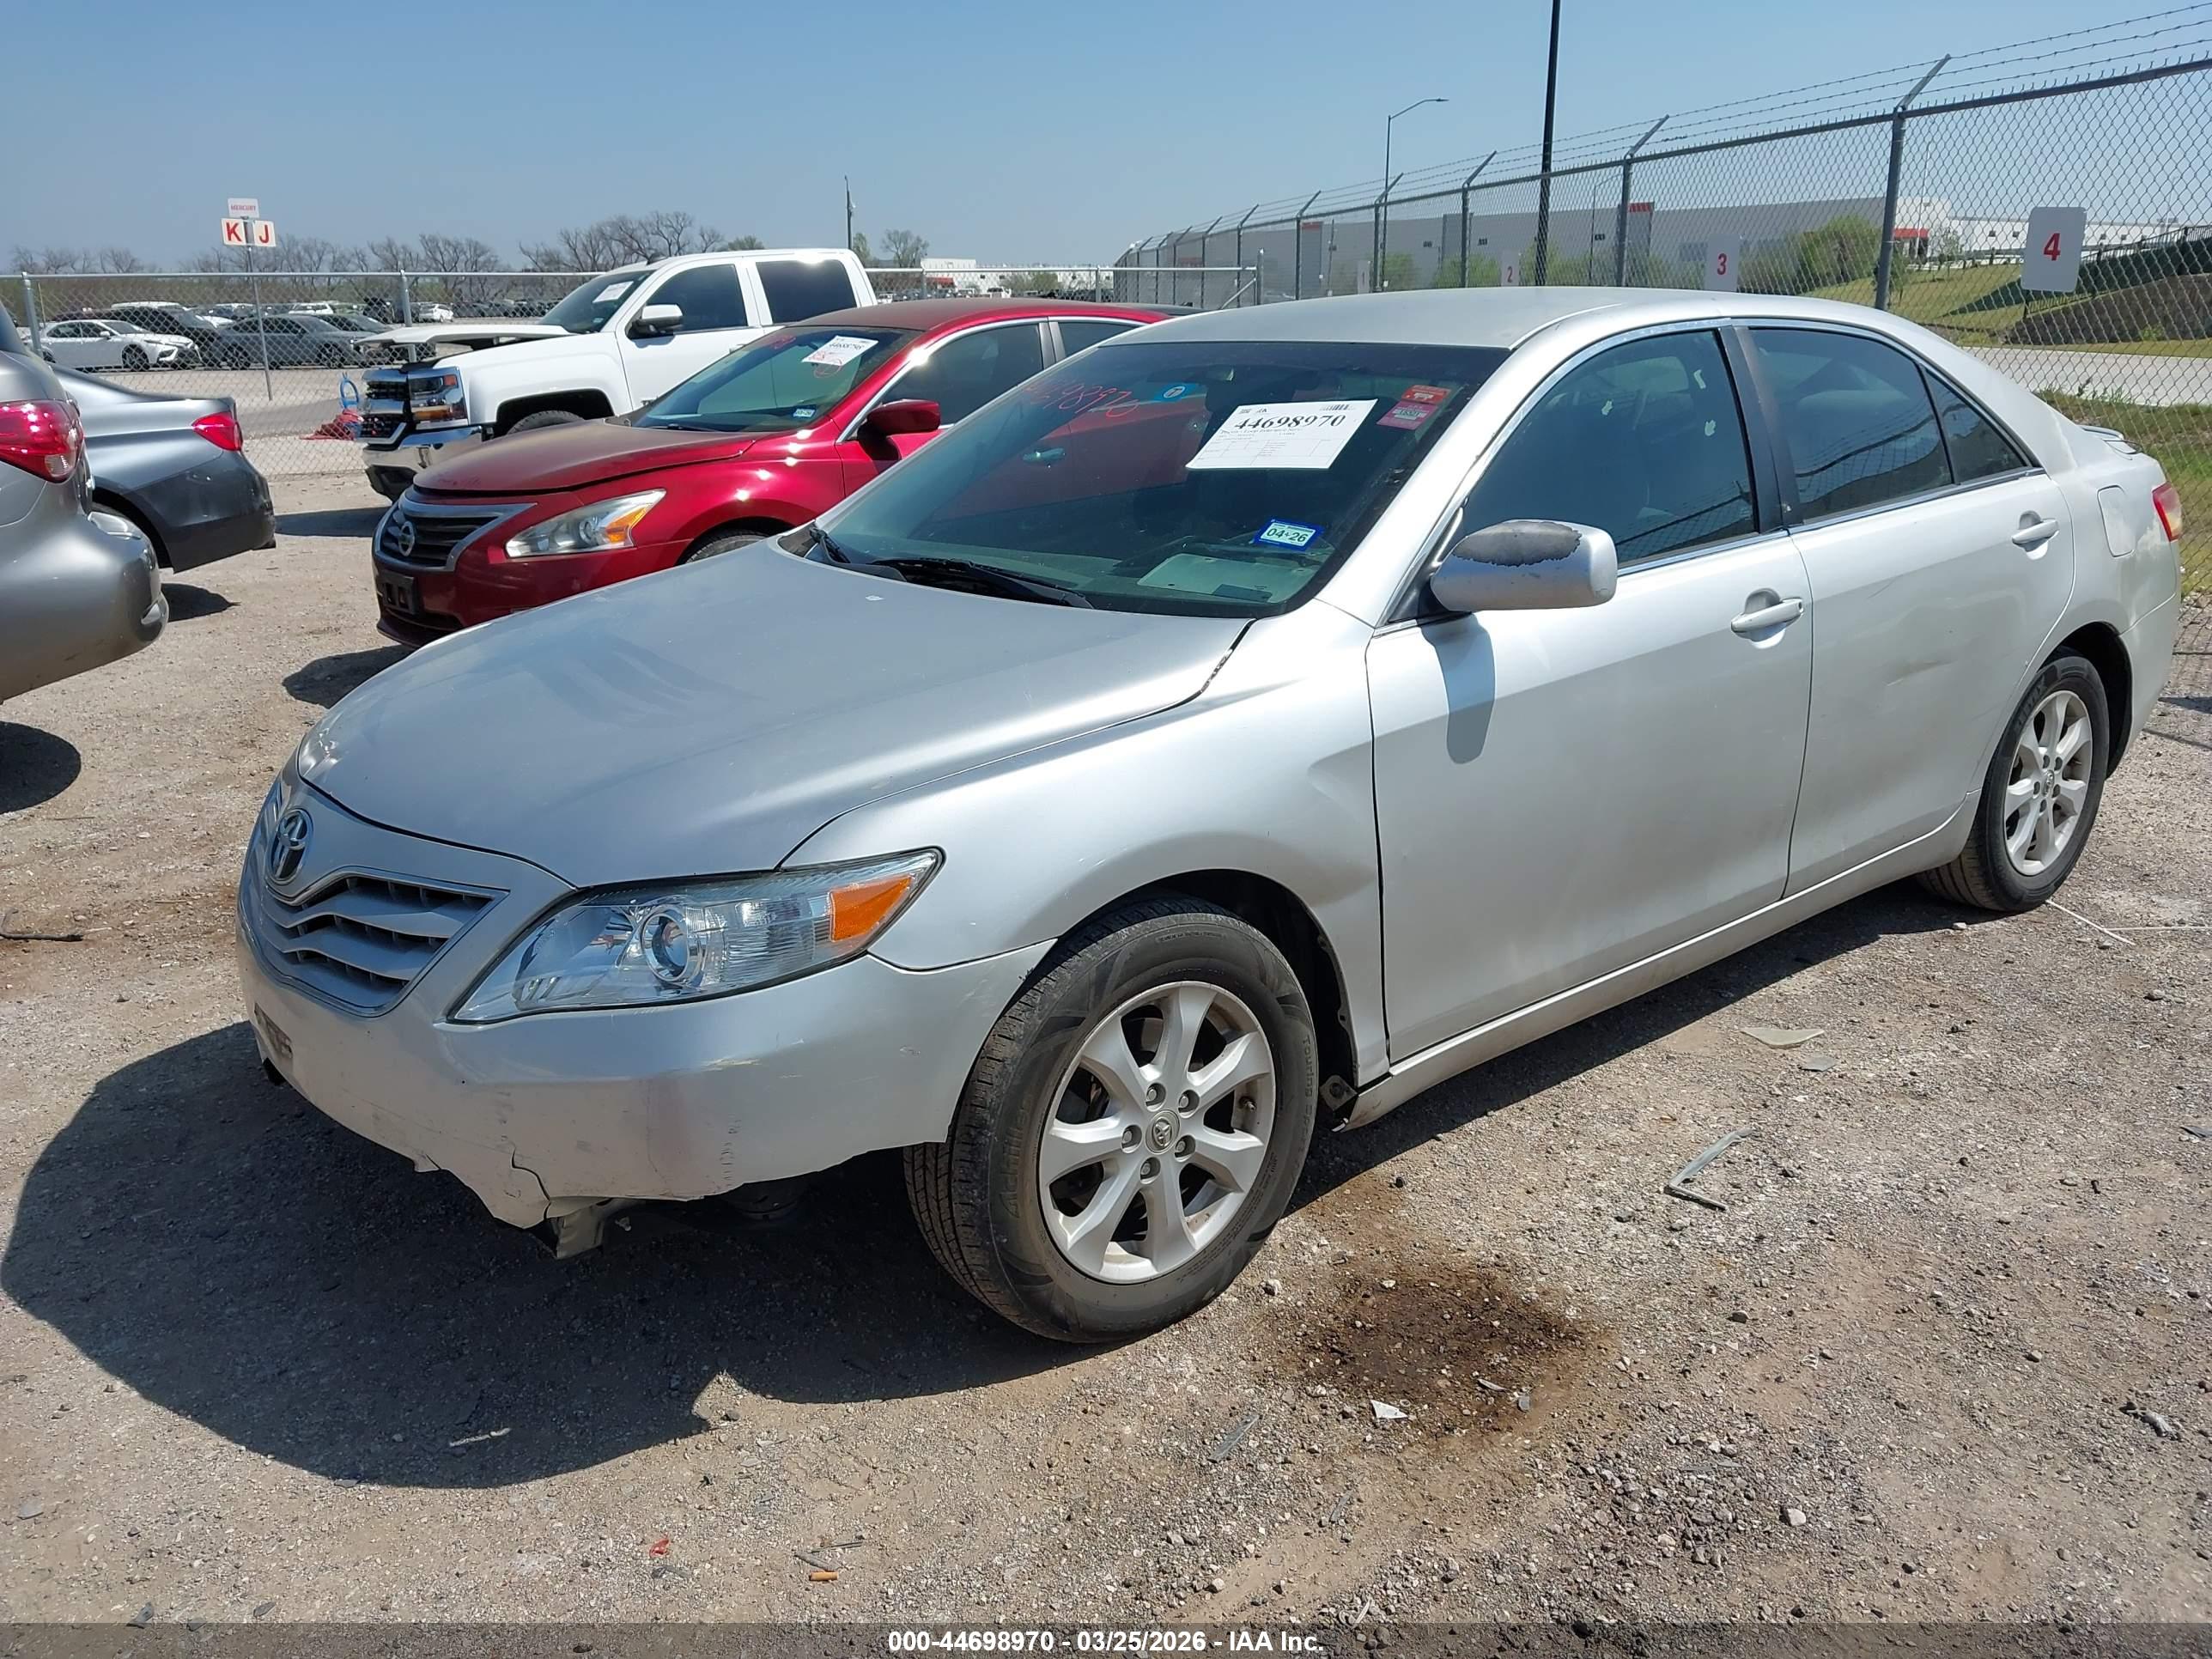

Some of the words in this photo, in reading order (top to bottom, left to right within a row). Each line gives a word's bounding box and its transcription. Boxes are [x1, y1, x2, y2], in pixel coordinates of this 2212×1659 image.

[226, 222, 242, 241] K
[258, 224, 269, 244] J
[2043, 233, 2061, 261] 4
[1507, 265, 1513, 283] 2
[1717, 252, 1727, 276] 3
[1234, 414, 1346, 429] 44698970
